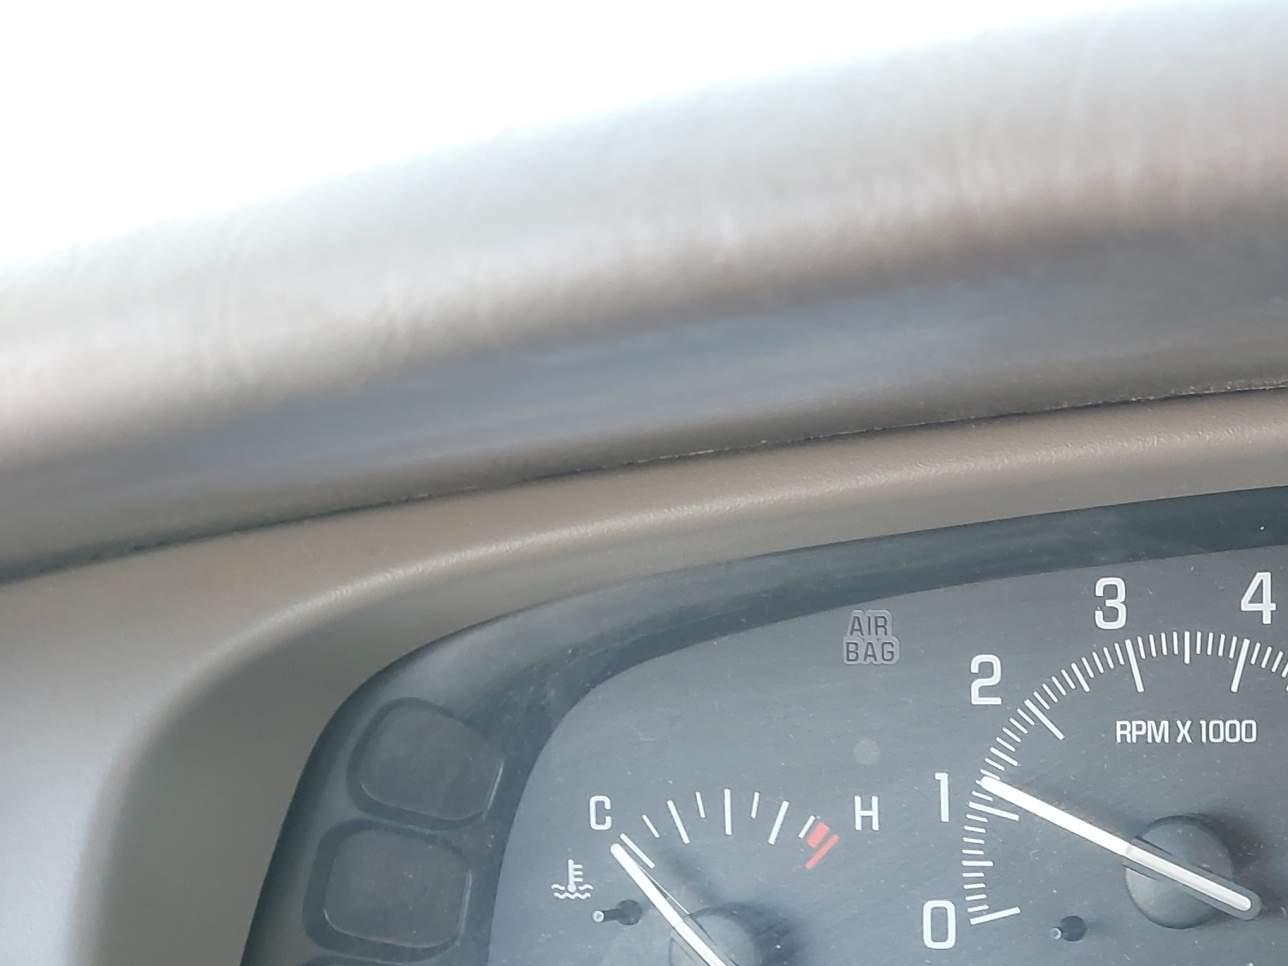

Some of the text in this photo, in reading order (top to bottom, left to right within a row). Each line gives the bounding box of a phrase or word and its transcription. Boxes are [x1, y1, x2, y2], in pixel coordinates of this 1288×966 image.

[1094, 577, 1128, 630] 3
[1240, 571, 1277, 624] 4
[849, 614, 889, 637] AIR
[845, 640, 895, 663] BAG
[970, 653, 1003, 706] 2
[1115, 719, 1258, 744] RPM X 1000
[589, 794, 613, 832] C
[854, 795, 880, 831] H
[935, 772, 951, 823] 1
[922, 900, 957, 950] 0
